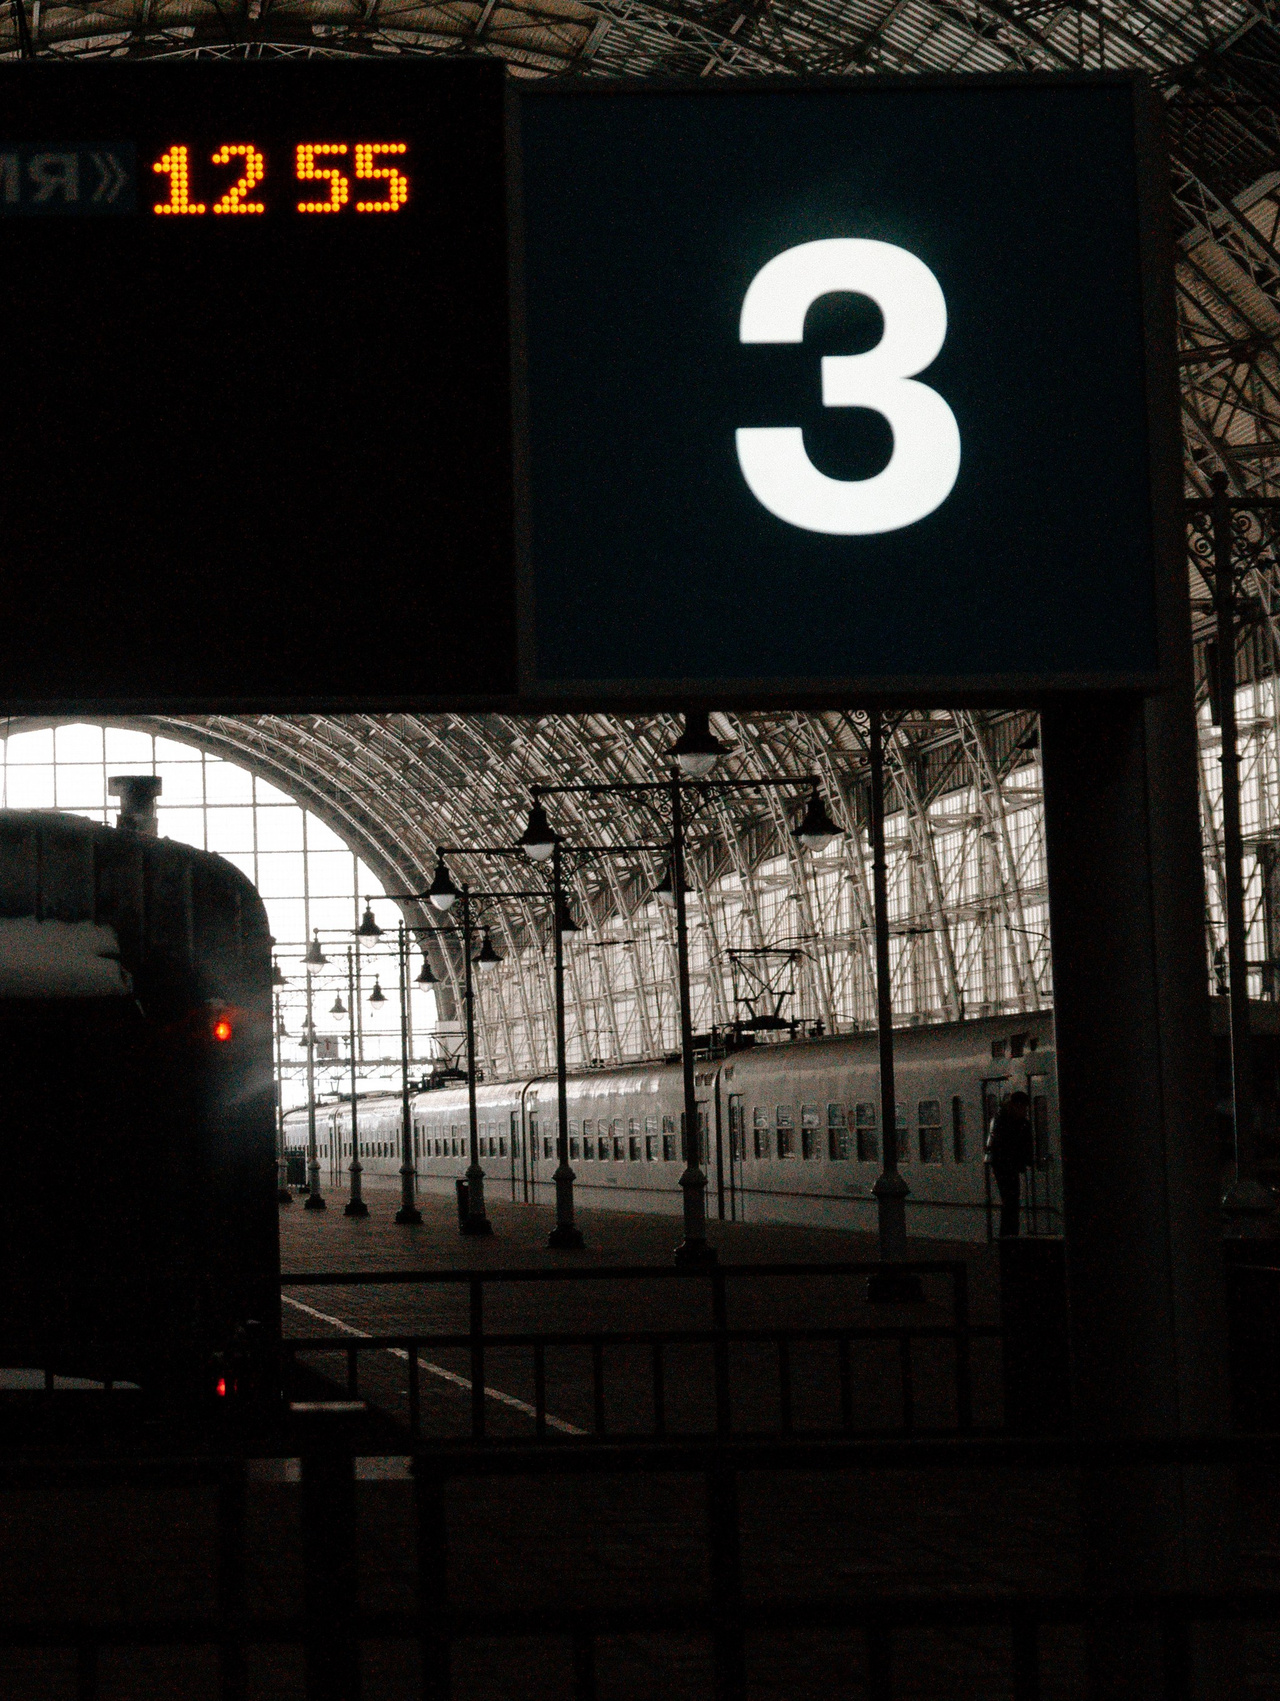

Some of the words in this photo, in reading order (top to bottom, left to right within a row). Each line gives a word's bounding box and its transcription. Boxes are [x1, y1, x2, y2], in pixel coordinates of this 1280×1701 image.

[152, 142, 266, 216] 12
[294, 141, 410, 215] 55
[734, 237, 961, 536] 3
